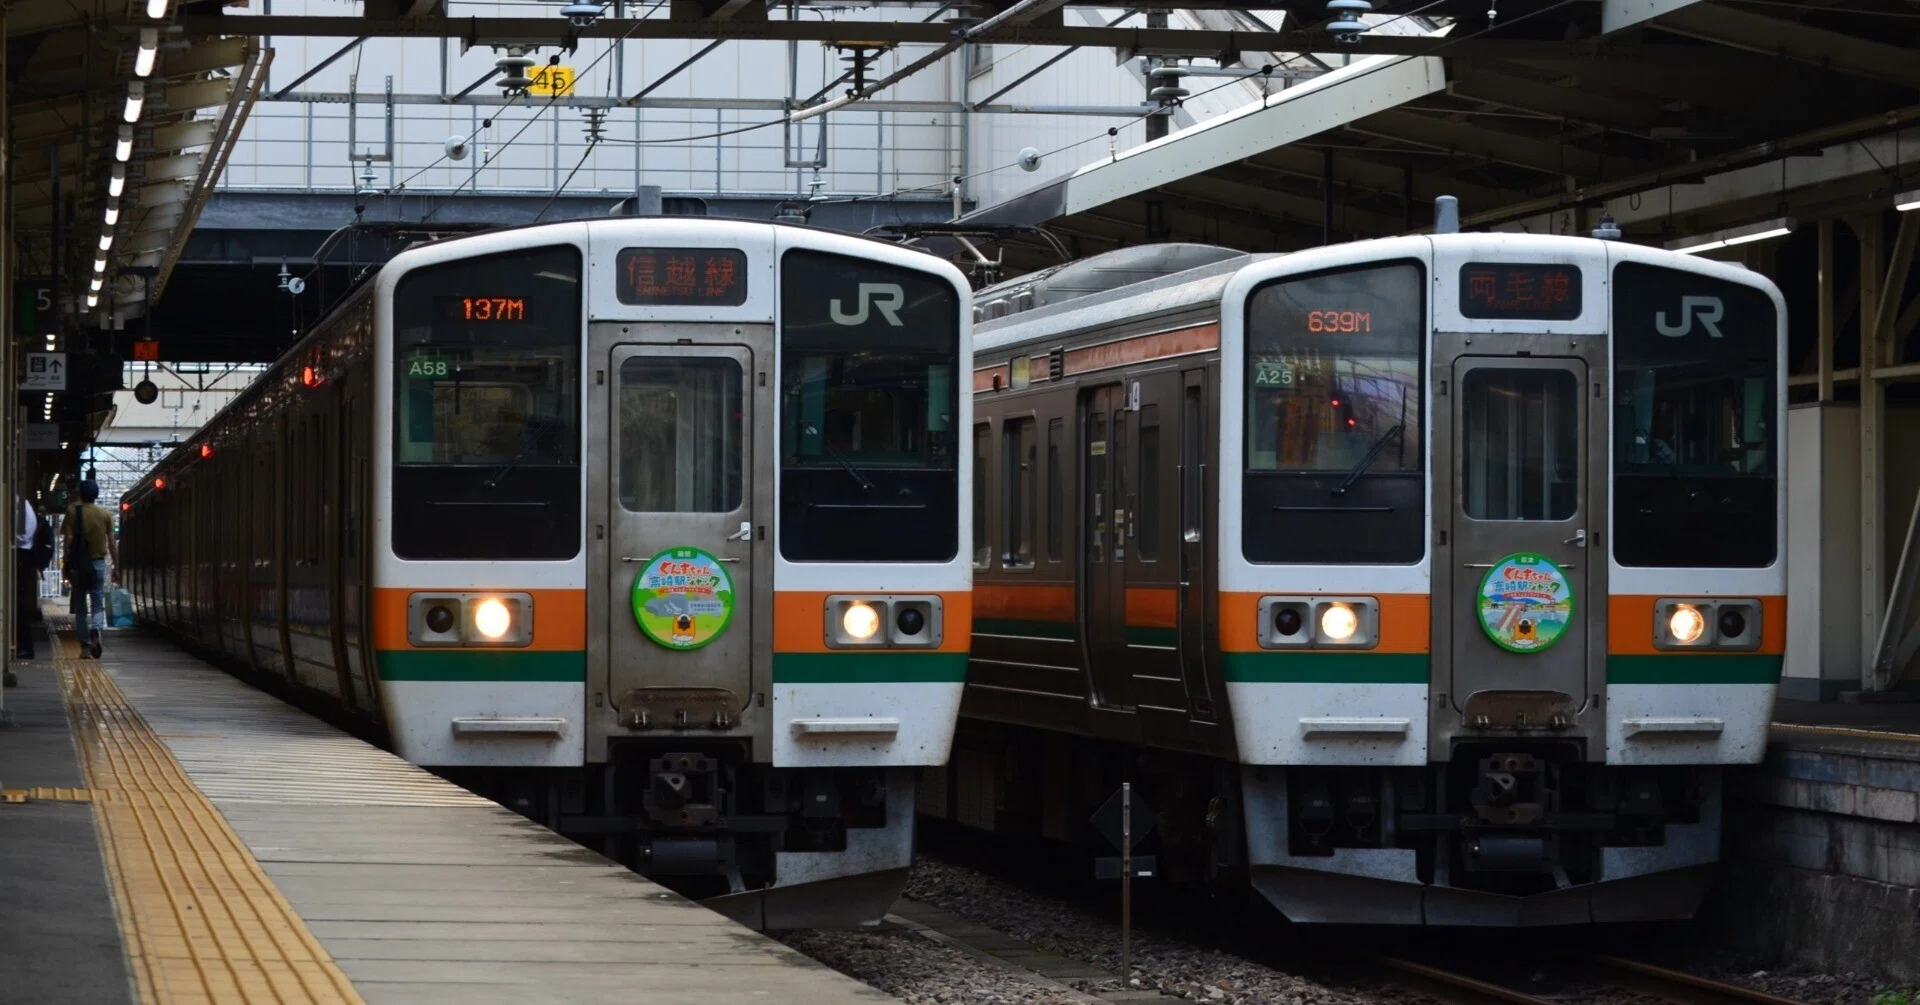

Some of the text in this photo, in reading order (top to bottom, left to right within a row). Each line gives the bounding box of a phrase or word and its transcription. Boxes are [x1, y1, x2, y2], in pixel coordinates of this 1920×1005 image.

[535, 71, 566, 90] 45
[627, 255, 736, 286] 信越線
[1467, 270, 1572, 303] 両毛線
[37, 288, 51, 311] 5
[463, 298, 524, 320] 137M
[829, 282, 905, 326] JR
[1308, 310, 1371, 333] 639M
[1655, 295, 1724, 338] JR
[408, 361, 447, 376] A58
[1255, 370, 1293, 385] A25
[659, 561, 711, 576] ぐんまちゃん
[1503, 566, 1551, 580] ぐんまちゃん
[648, 575, 721, 588] 高崎駅ジャック
[1494, 581, 1561, 593] 高崎駅ジャック
